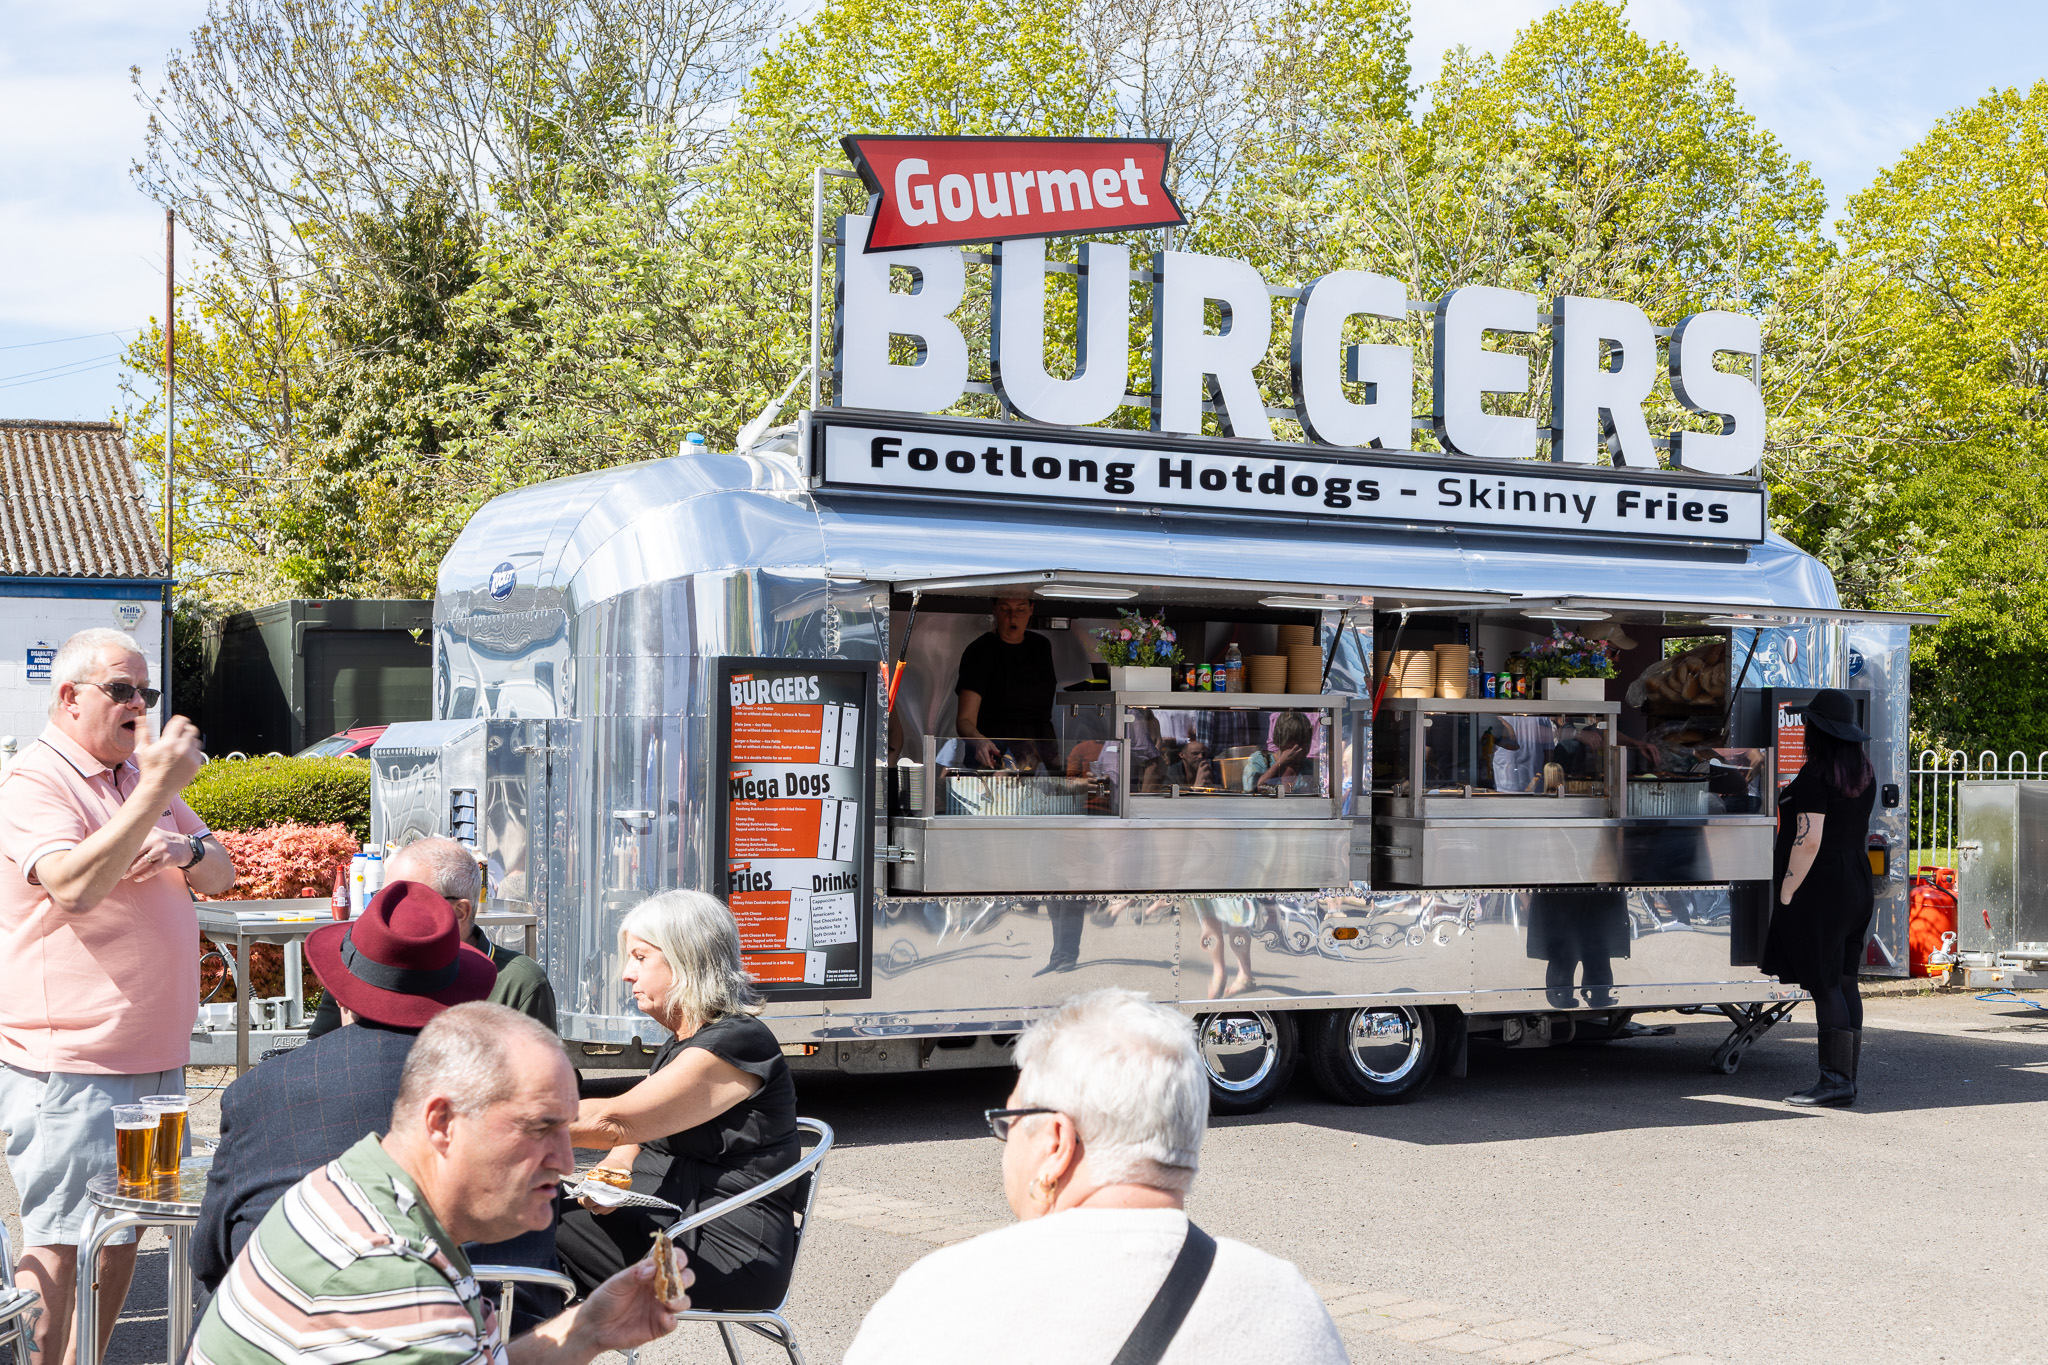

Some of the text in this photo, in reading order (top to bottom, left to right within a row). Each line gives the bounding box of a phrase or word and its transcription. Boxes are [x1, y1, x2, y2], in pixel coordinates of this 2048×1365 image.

[894, 157, 1149, 227] Gourmet
[838, 214, 1766, 475] BURGERS
[870, 437, 1135, 495] Footlong
[1158, 458, 1380, 509] Hotdogs
[1437, 477, 1597, 524] Skinny
[1616, 489, 1729, 523] Fries
[120, 606, 140, 614] Hill's
[730, 675, 820, 706] BURGERS
[729, 772, 830, 801] Mega Dogs
[727, 868, 773, 894] Fries
[812, 871, 858, 893] Drinks
